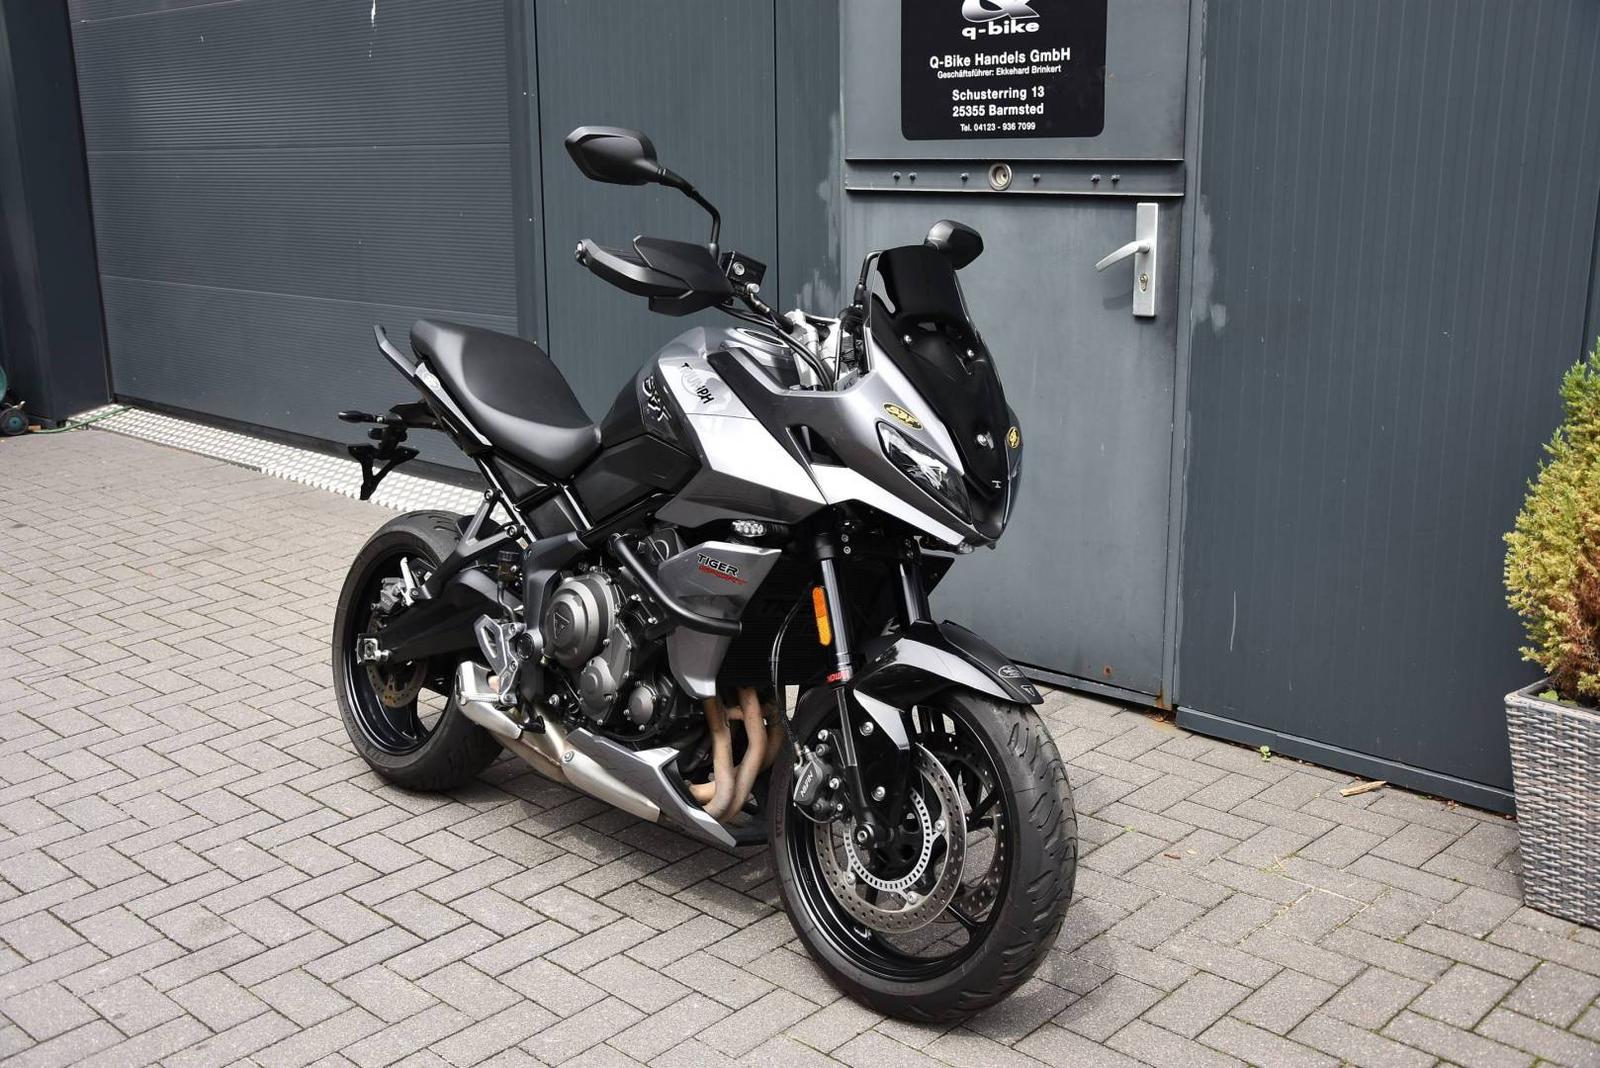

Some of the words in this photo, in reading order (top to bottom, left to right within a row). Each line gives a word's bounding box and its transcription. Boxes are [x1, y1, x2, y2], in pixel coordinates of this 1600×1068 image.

[961, 20, 1040, 40] q-bike
[929, 54, 971, 69] Q-Bike
[974, 50, 1026, 66] Handels
[1029, 47, 1071, 63] GmbH
[937, 69, 994, 79] Geschäftsführer:
[996, 66, 1030, 76] Ekkehard
[1031, 64, 1061, 74] Brinkert
[952, 87, 1027, 102] Schusterring
[1031, 85, 1045, 98] 13
[952, 104, 985, 117] 25355
[989, 102, 1044, 116] Barmsted
[960, 123, 972, 132] Tel.
[974, 122, 996, 131] 04123
[1002, 122, 1016, 131] 936
[1018, 121, 1036, 131] 7099
[697, 553, 739, 576] TIGER
